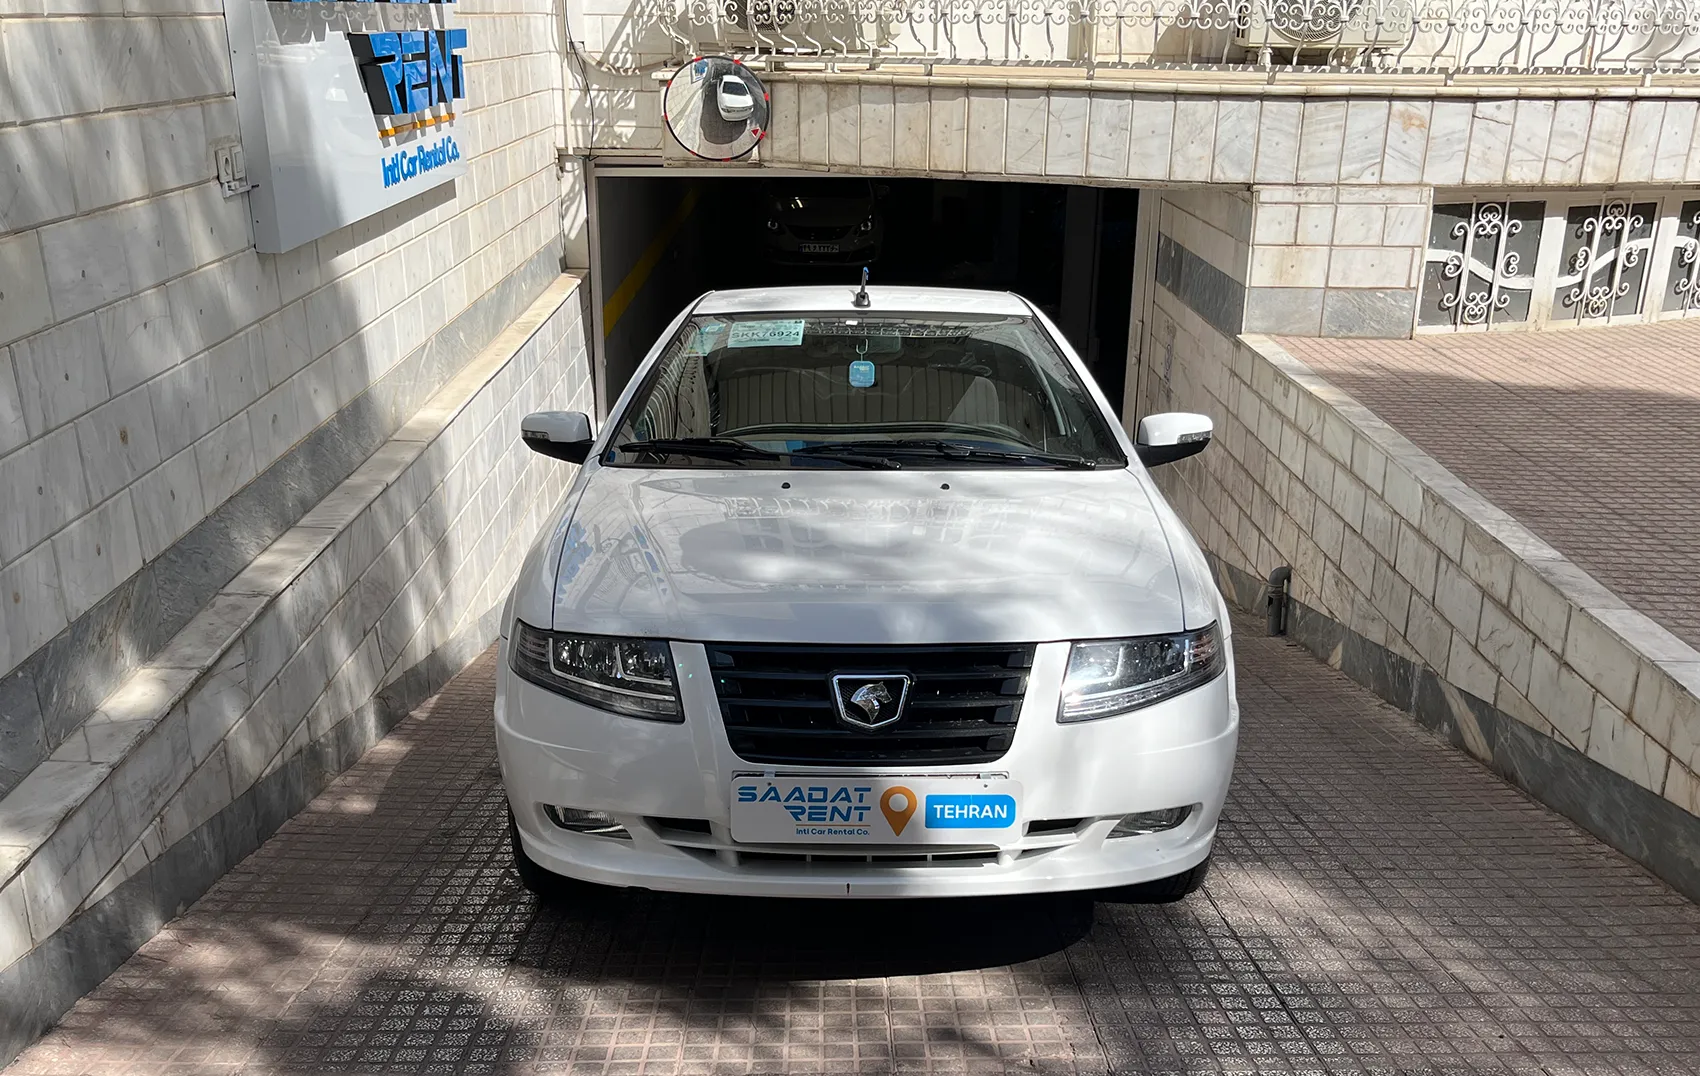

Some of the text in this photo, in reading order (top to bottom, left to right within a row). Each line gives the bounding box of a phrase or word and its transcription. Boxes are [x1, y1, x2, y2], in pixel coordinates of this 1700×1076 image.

[369, 28, 468, 115] RENT
[381, 135, 460, 189] Intl Car Rental Co.
[731, 331, 800, 339] SKK76924
[738, 786, 872, 803] SAADAT
[783, 805, 872, 822] RENT
[933, 804, 1008, 819] TEHRAN
[796, 828, 870, 836] Intl Car Rental Co.
